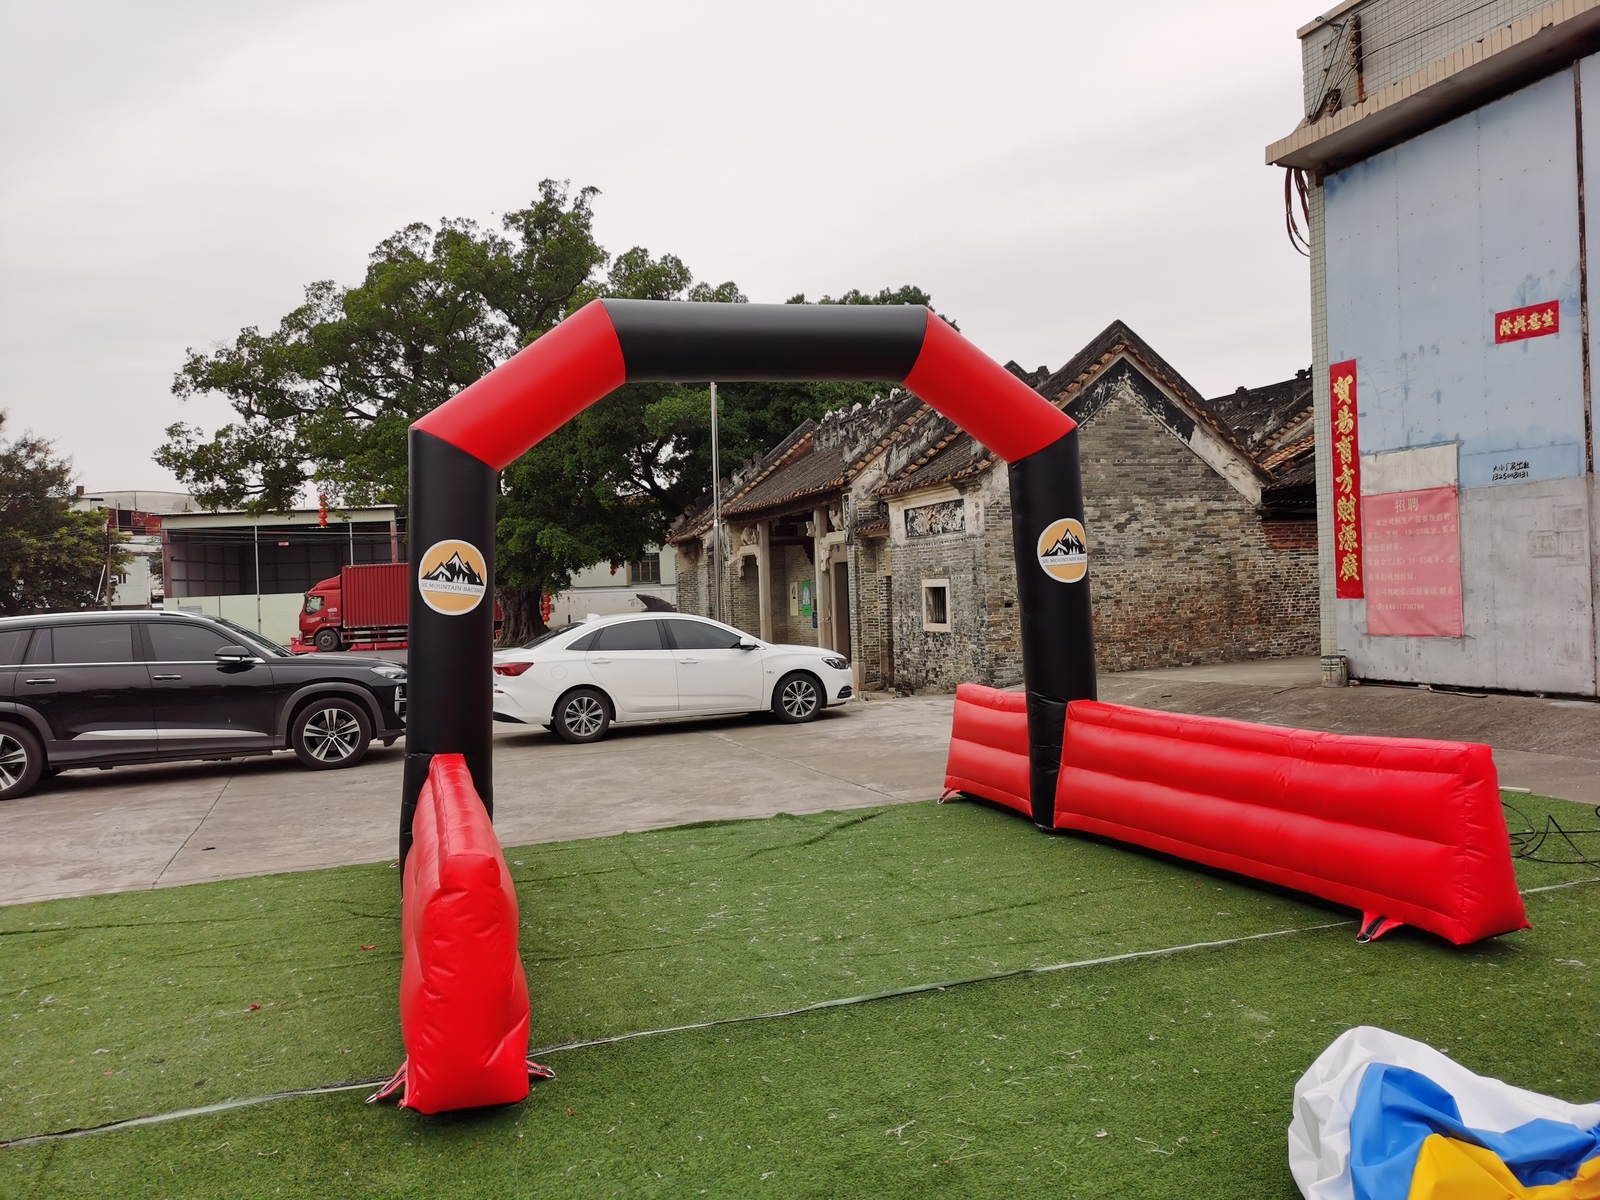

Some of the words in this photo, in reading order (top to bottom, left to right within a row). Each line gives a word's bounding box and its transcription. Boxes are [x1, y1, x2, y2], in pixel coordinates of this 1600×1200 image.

[1394, 497, 1419, 513] 招聘
[429, 583, 462, 591] MOUNTAIN
[463, 586, 484, 594] RACING
